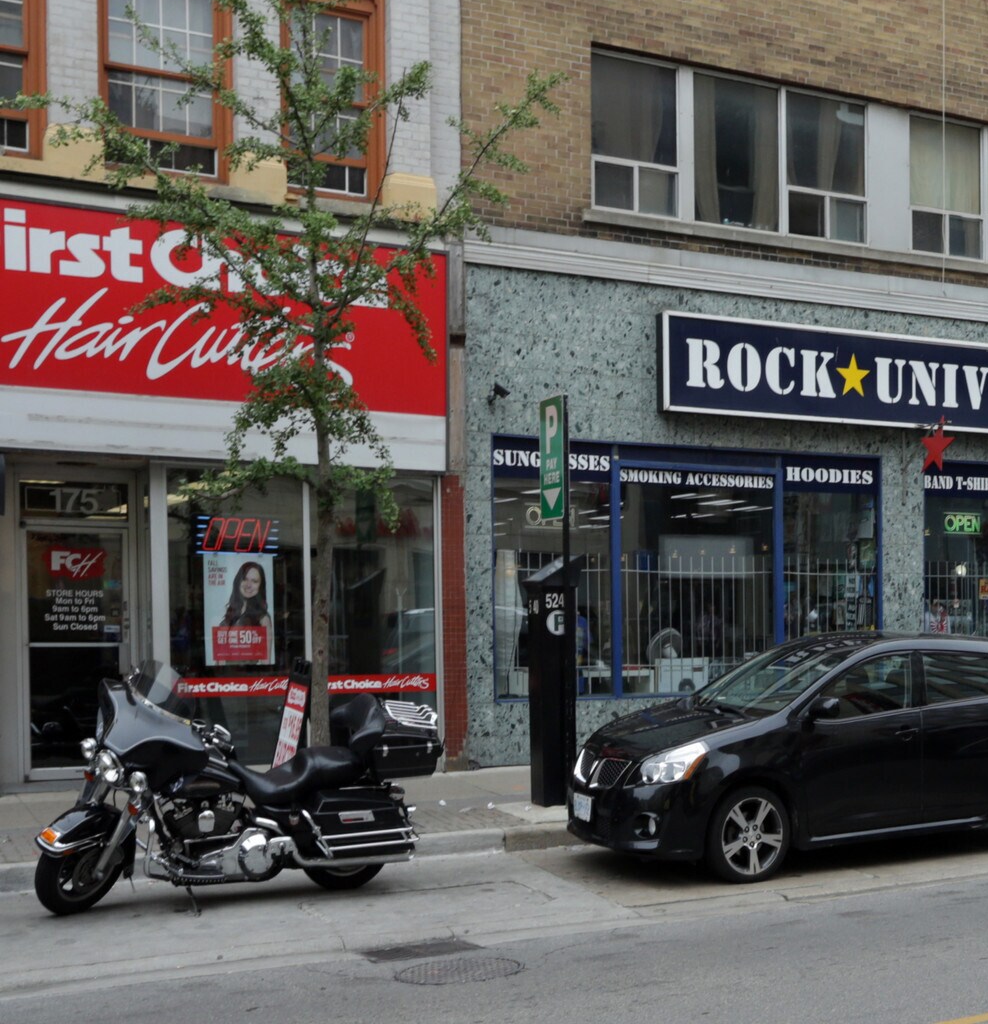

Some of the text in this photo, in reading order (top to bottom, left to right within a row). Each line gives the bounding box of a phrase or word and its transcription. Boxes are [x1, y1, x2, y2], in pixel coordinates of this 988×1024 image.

[4, 208, 144, 283] irst
[686, 338, 836, 399] ROCK
[546, 405, 558, 454] P
[493, 449, 610, 472] SUNGSSES
[546, 458, 558, 471] PAY
[544, 471, 561, 486] HERE
[619, 469, 774, 489] SMOKING ACCESSORIES
[786, 466, 874, 485] HOODIES
[923, 475, 954, 490] BAND
[50, 488, 98, 514] 175
[944, 514, 981, 533] OPEN
[202, 517, 272, 552] OPEN
[46, 589, 104, 598] STORE HOURS
[45, 614, 106, 623] Sat 9am to 6pm
[81, 606, 99, 615] 6pm
[53, 623, 69, 631] Sun
[70, 623, 98, 631] Closed
[177, 682, 206, 694] First
[206, 682, 249, 693] Choice
[343, 679, 383, 689] Choice
